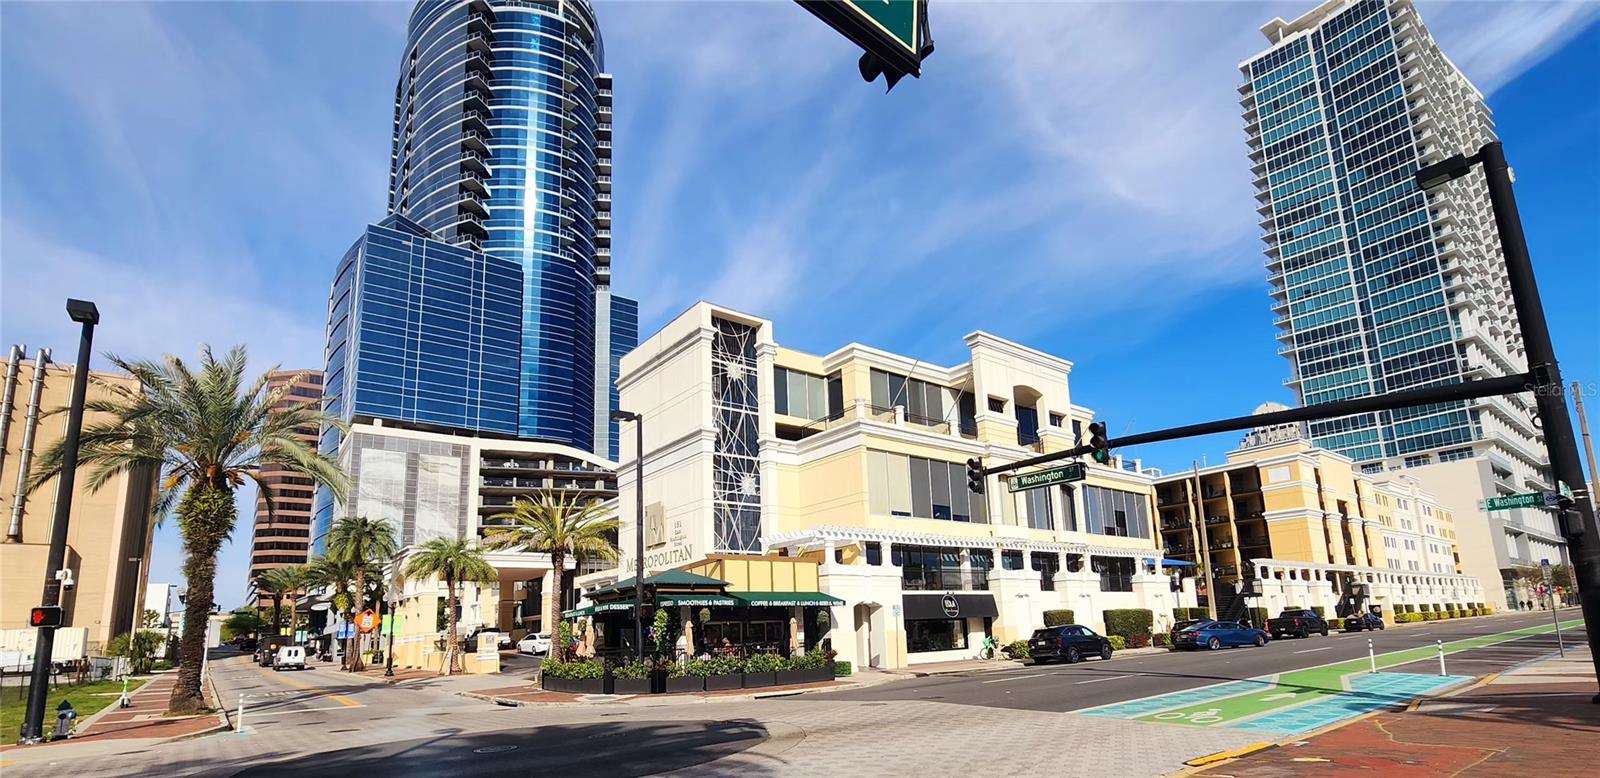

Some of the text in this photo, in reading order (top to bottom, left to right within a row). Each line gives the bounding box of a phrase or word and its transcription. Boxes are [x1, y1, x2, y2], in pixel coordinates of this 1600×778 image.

[1020, 470, 1064, 485] Washington
[1487, 499, 1492, 508] E
[1494, 495, 1535, 507] Washington
[626, 543, 693, 573] MEROPOLITAN
